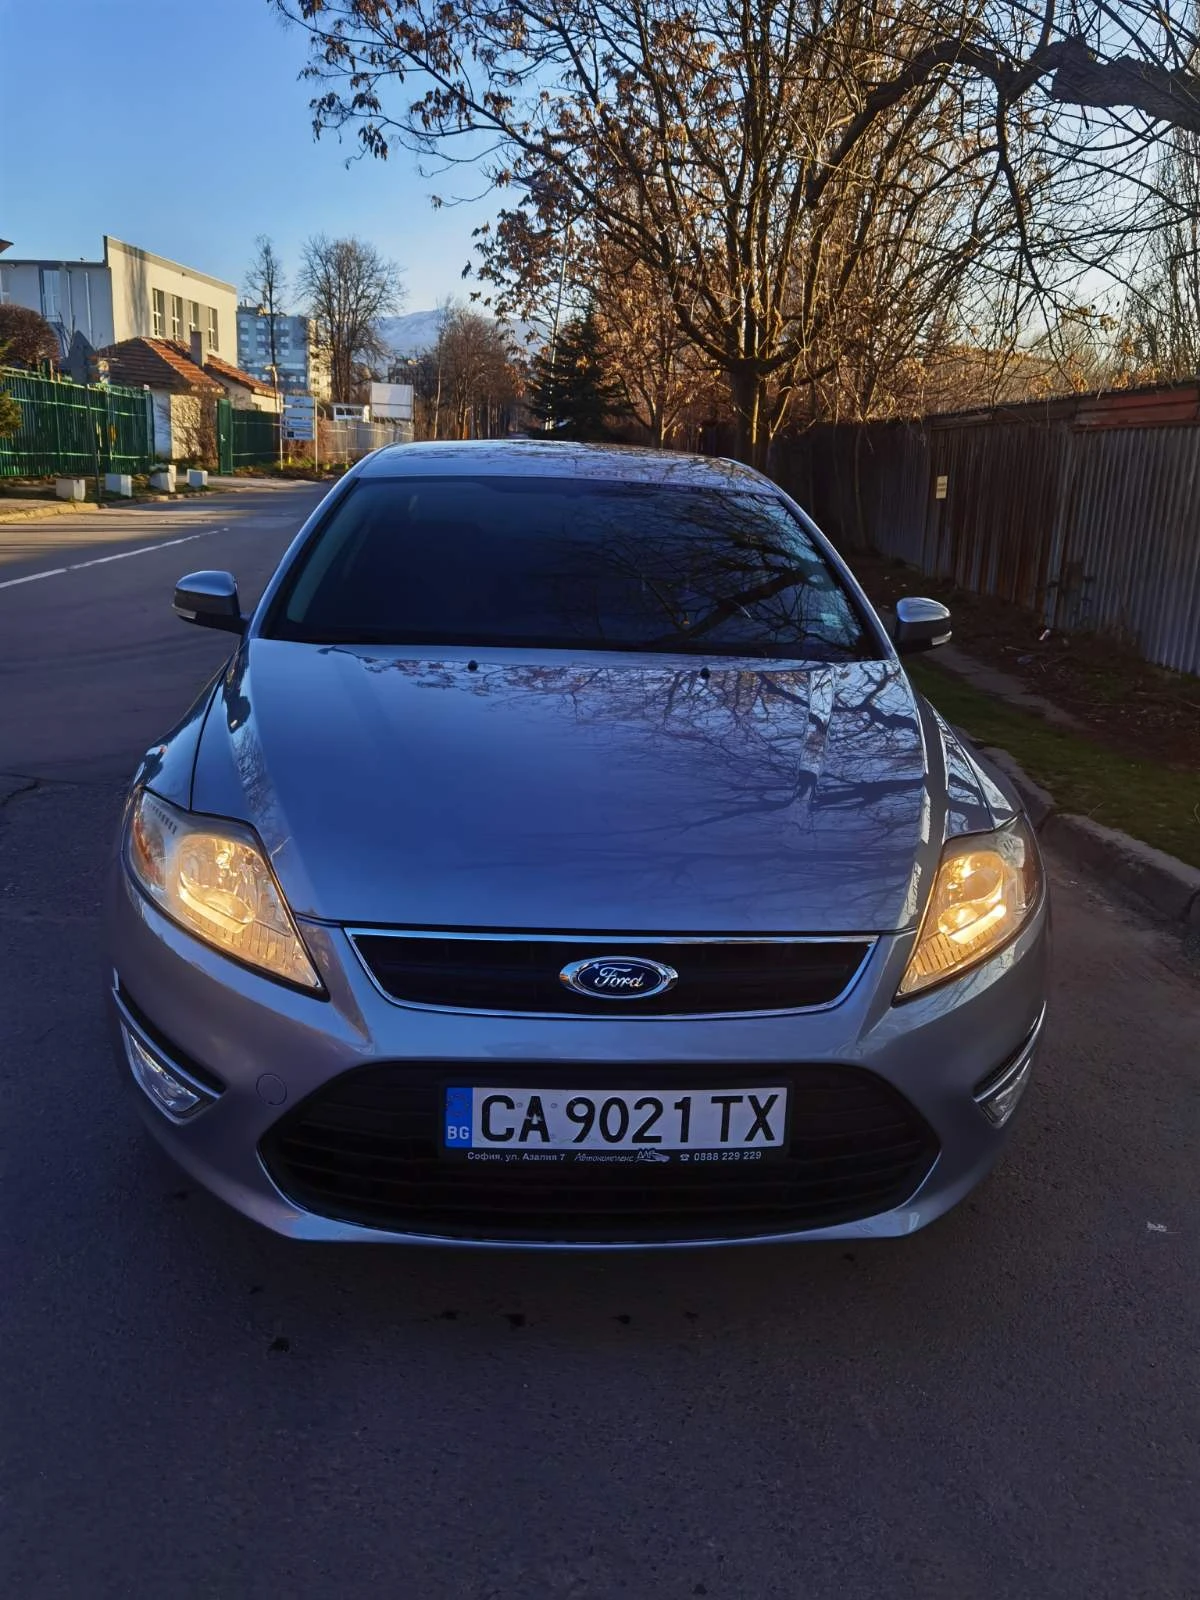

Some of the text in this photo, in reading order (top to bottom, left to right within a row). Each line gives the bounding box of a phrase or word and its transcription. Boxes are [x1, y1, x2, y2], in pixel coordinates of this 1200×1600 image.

[594, 966, 645, 987] Ford
[481, 1094, 779, 1143] CA 9021 TX
[447, 1126, 470, 1140] BG
[559, 1153, 566, 1161] 7
[721, 1151, 741, 1161] 229
[743, 1150, 762, 1160] 229
